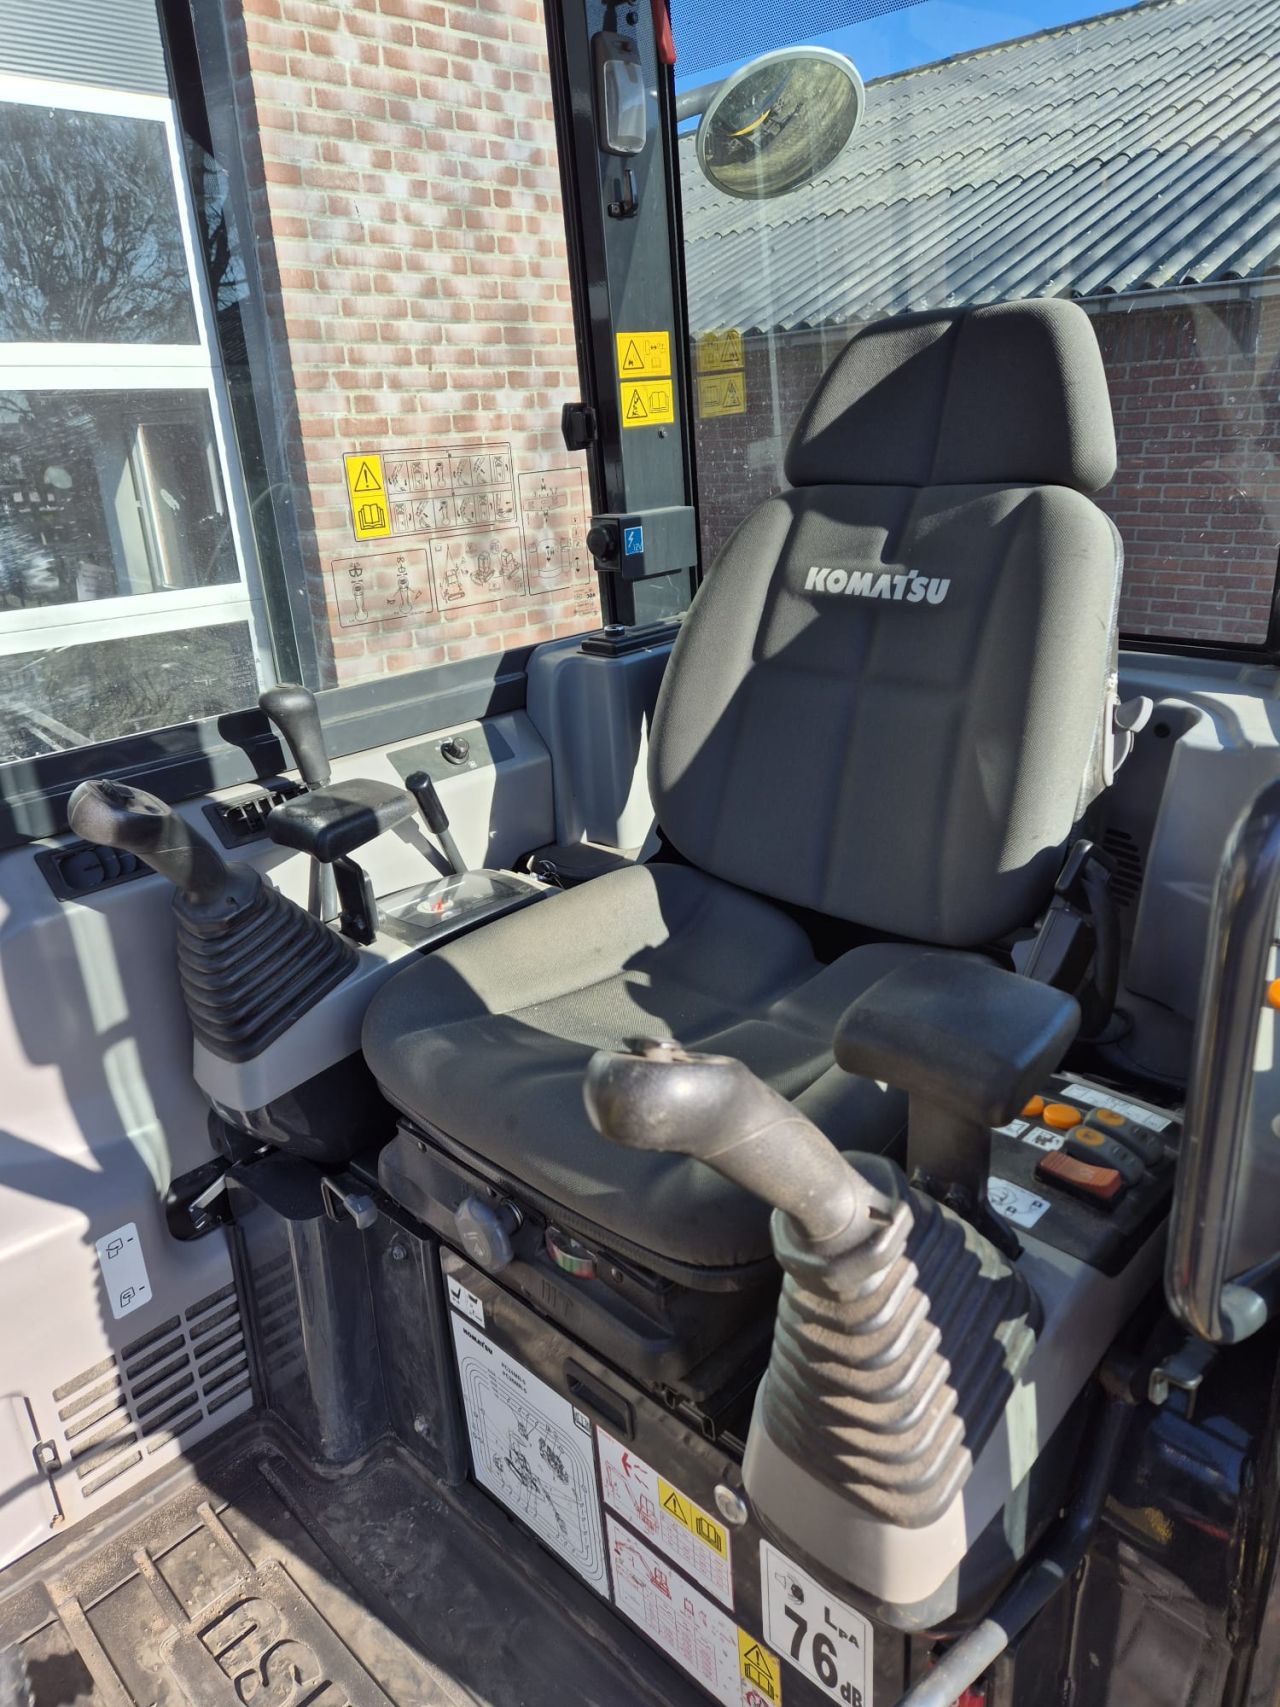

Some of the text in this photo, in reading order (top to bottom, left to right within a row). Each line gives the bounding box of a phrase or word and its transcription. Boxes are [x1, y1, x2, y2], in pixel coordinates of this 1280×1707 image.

[805, 566, 951, 605] KOMATSU
[784, 1604, 863, 1707] 76 dB
